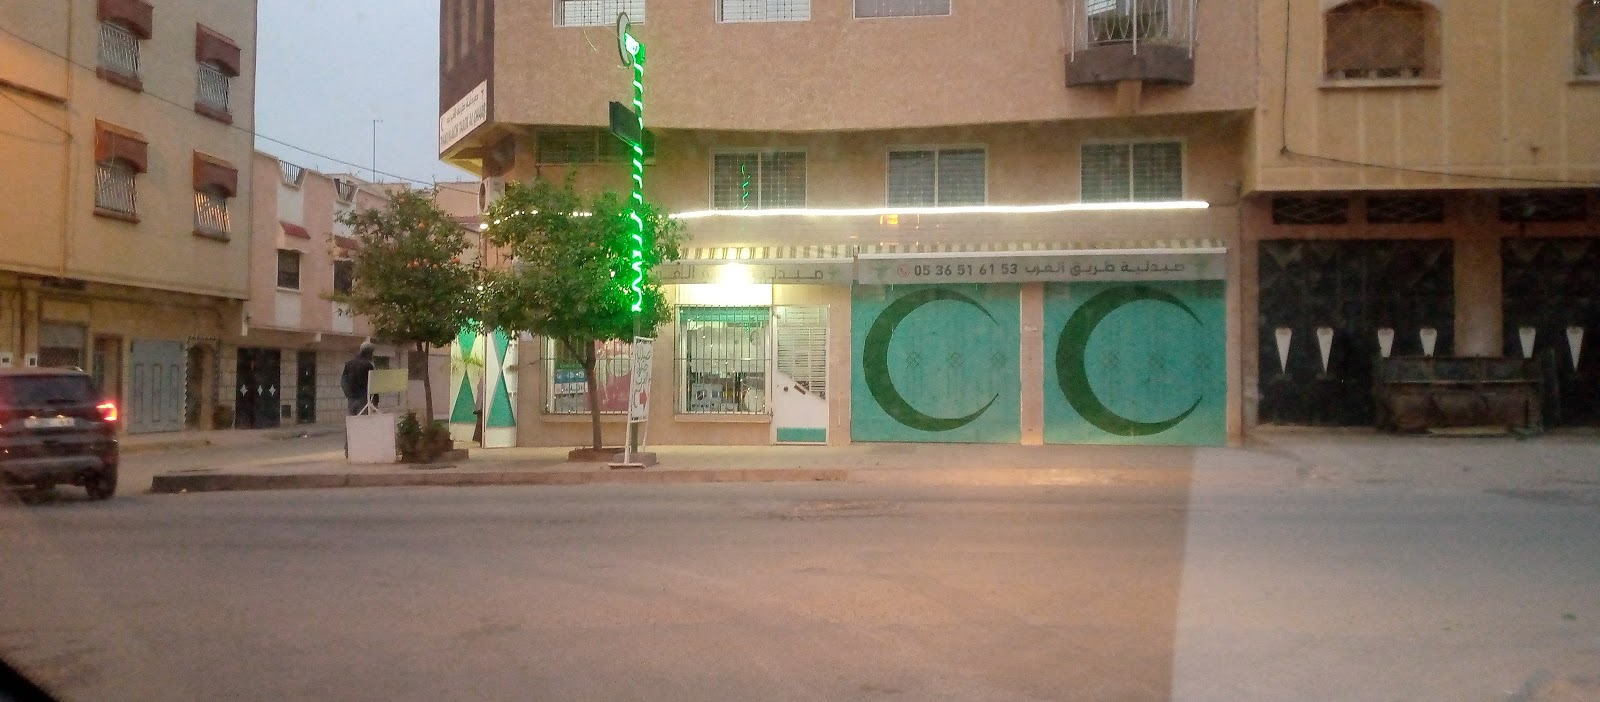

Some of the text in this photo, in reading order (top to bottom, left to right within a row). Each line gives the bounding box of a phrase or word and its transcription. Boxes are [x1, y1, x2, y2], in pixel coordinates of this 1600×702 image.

[914, 263, 1018, 276] 05 36 51 61 53
[1070, 259, 1115, 277] طريق
[1120, 261, 1185, 276] صيدلية
